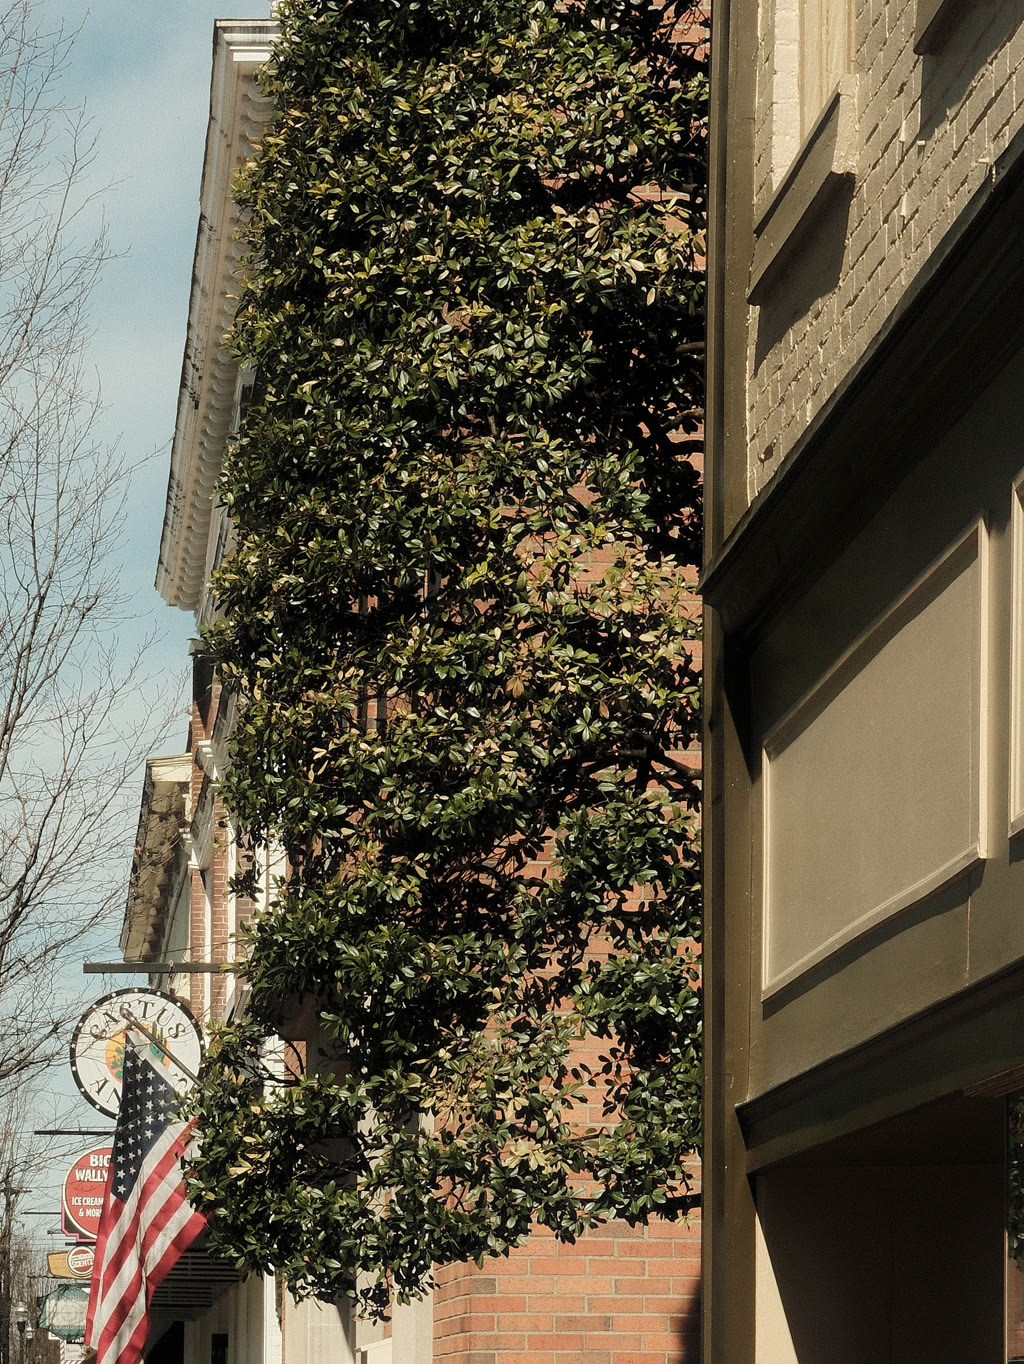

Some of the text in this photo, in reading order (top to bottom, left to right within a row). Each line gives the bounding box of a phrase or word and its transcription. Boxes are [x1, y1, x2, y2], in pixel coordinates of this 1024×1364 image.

[89, 1000, 186, 1039] CACTUS
[72, 1196, 82, 1206] ICE
[78, 1208, 84, 1217] &
